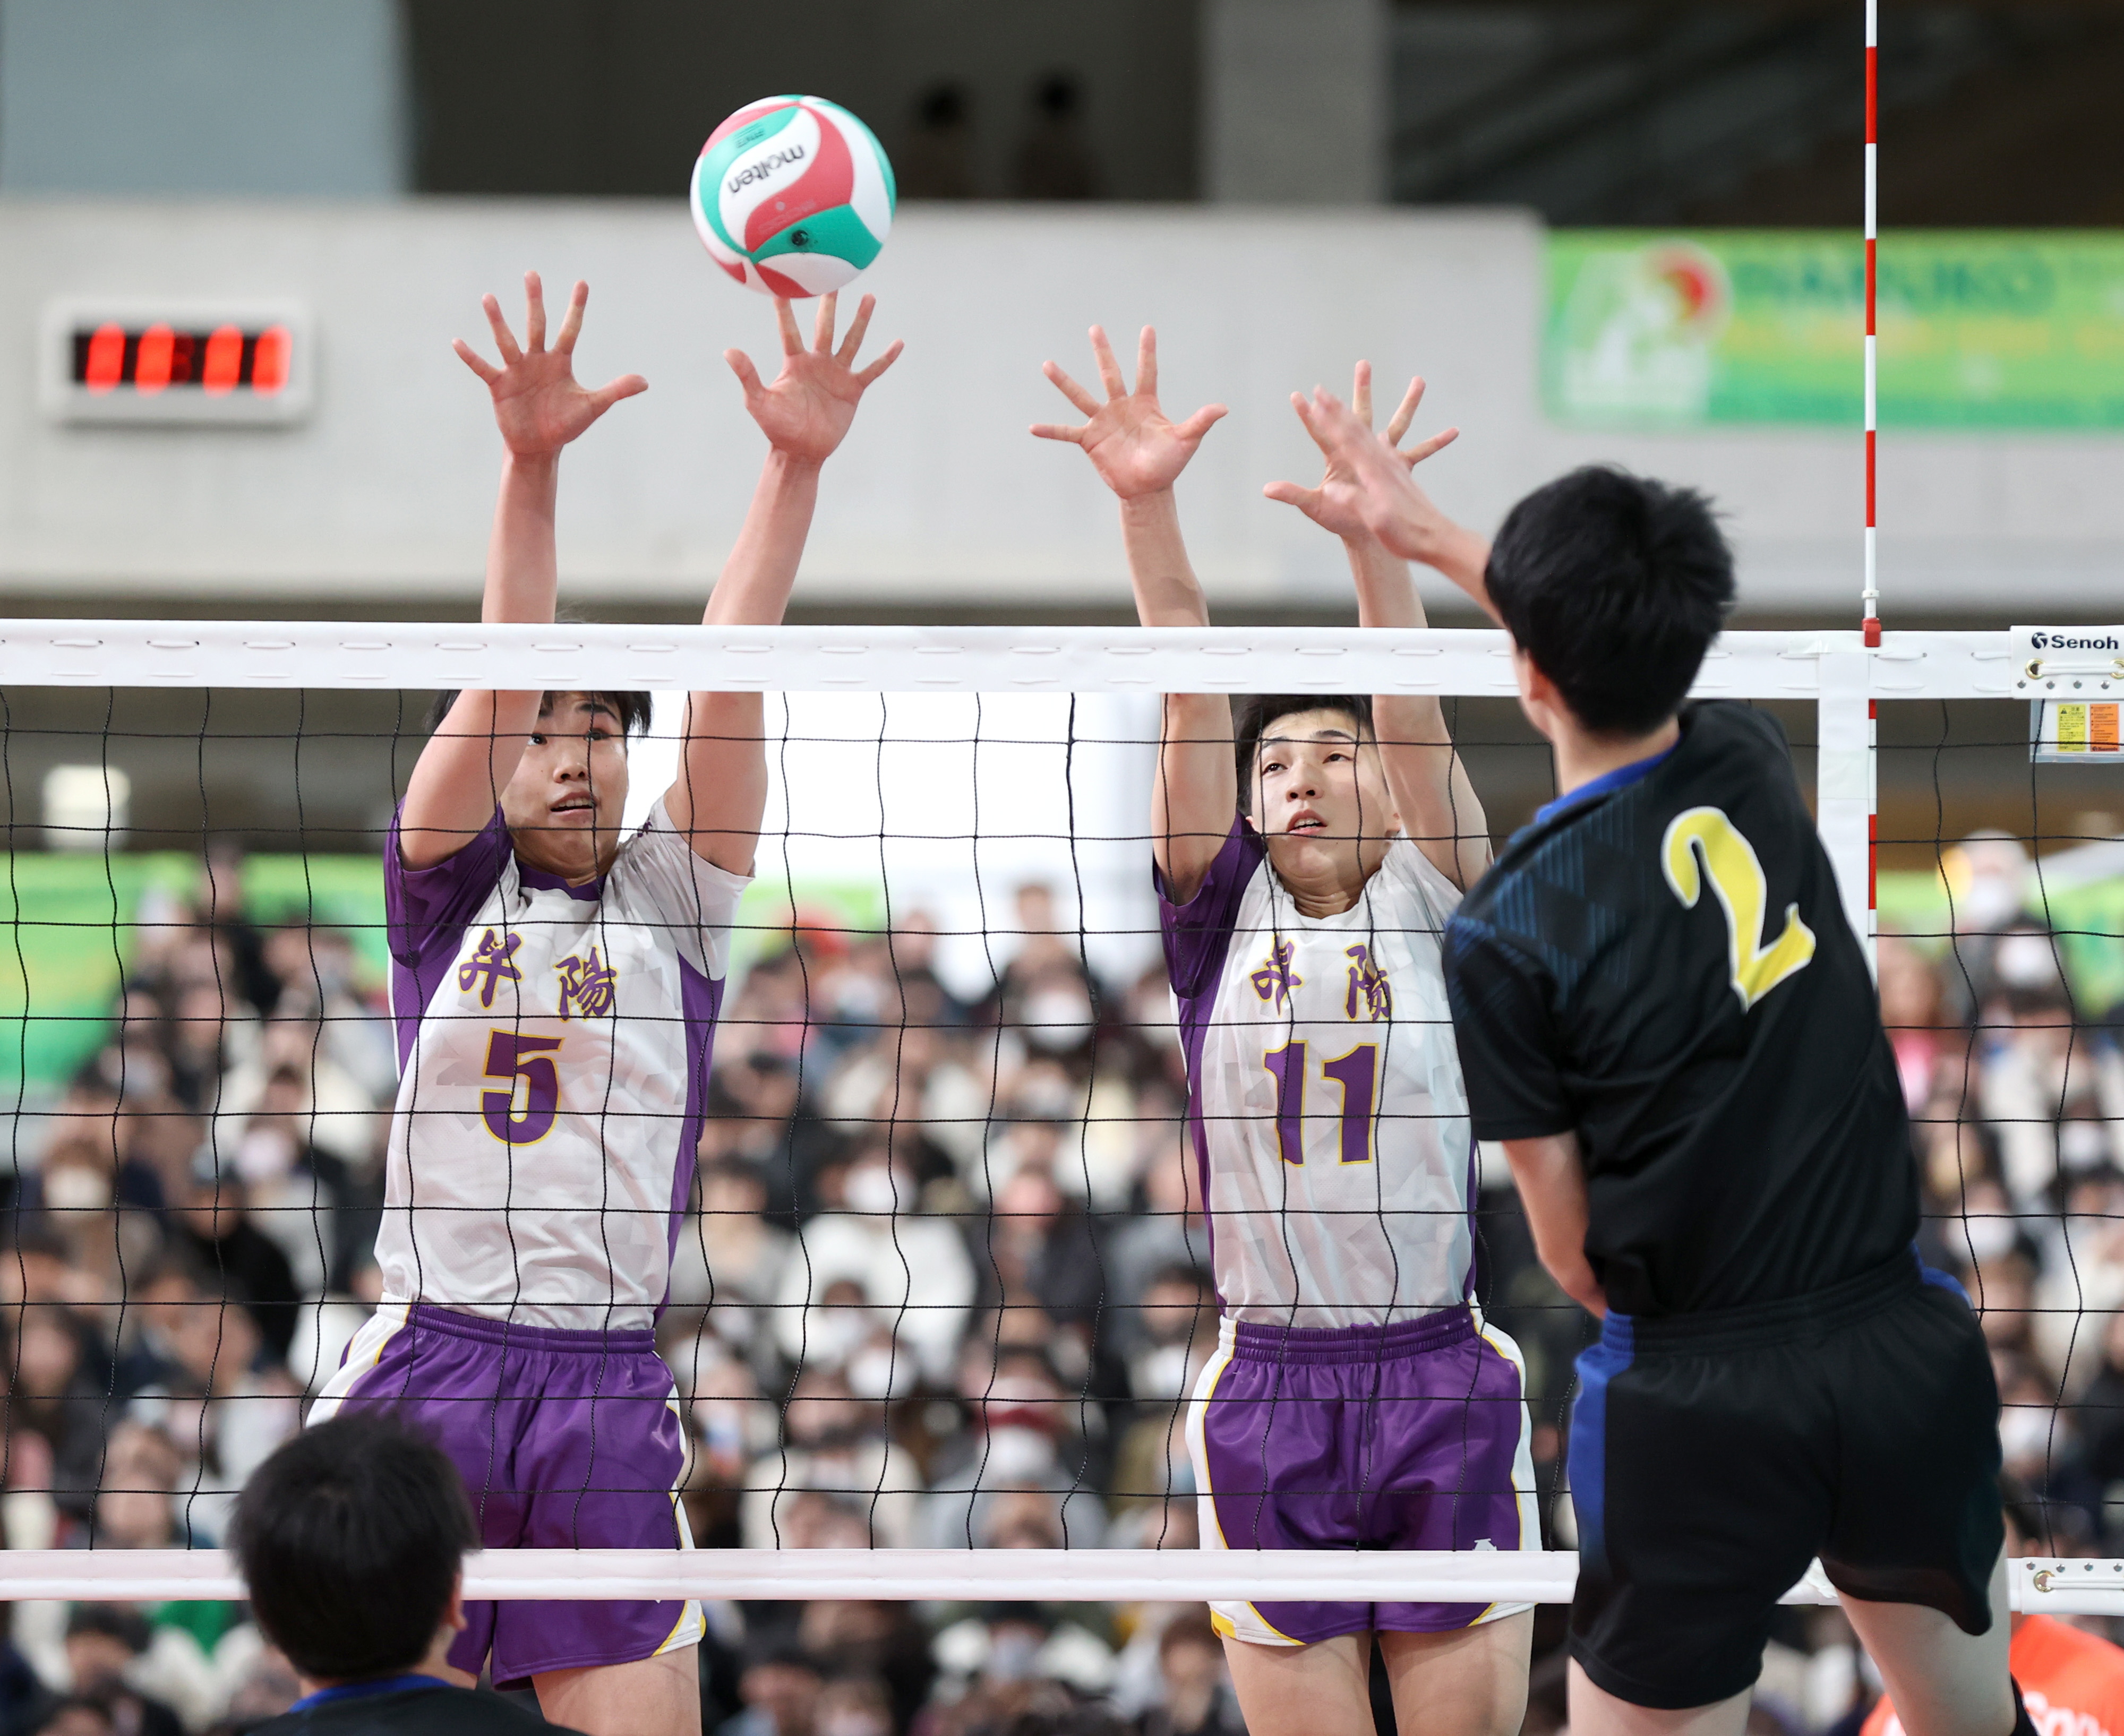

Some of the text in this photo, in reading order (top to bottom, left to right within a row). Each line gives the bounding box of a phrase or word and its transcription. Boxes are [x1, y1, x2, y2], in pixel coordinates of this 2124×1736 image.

[729, 145, 805, 193] molten
[2051, 635, 2119, 649] Senoh
[1660, 806, 1816, 1015] 2
[481, 1027, 565, 1147] 5
[1262, 1039, 1379, 1167] 11
